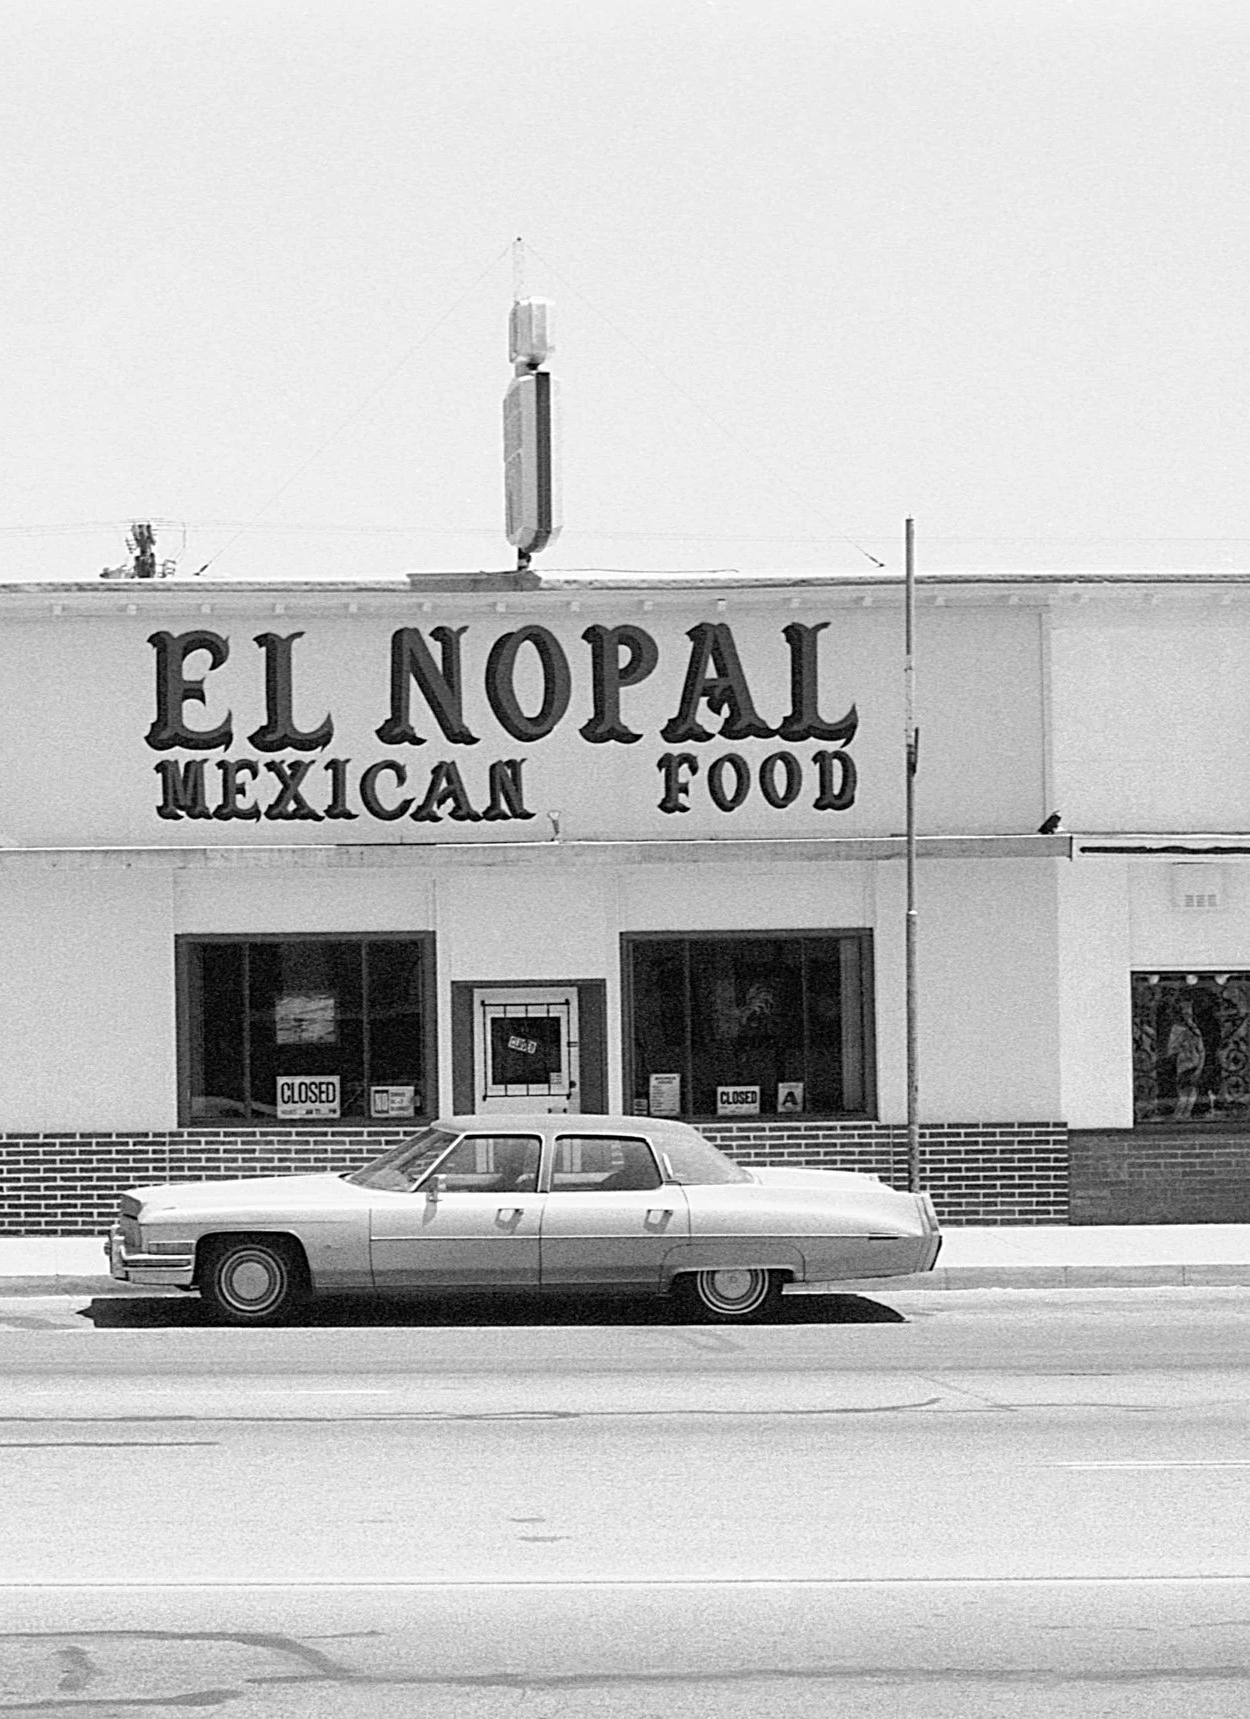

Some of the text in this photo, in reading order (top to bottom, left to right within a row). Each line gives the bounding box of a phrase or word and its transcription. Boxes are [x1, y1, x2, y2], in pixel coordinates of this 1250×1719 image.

[144, 622, 858, 752] EL NOPAL
[153, 750, 857, 822] MEXICAN FOOD
[281, 1081, 336, 1104] CLOSED
[720, 1091, 757, 1104] CLOSED
[782, 1091, 798, 1105] A
